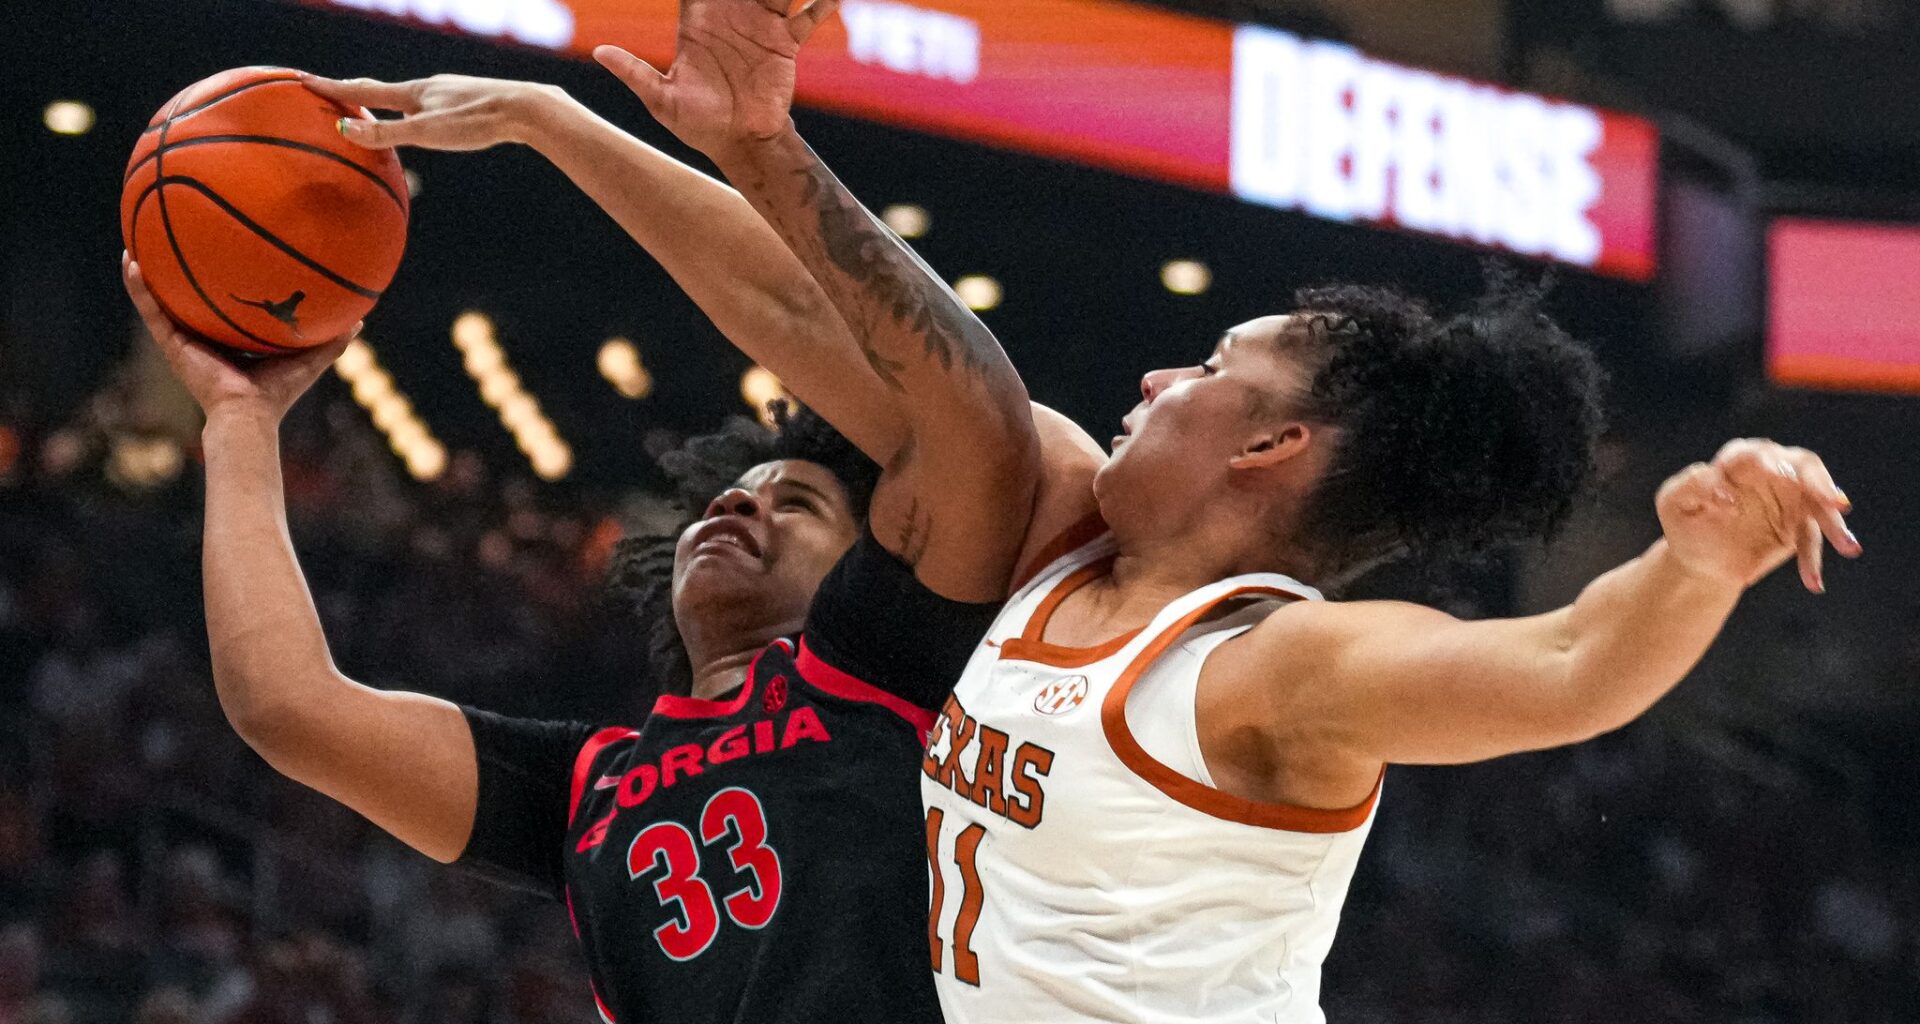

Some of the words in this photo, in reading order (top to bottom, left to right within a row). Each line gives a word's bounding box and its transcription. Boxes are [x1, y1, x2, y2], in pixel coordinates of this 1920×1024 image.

[1231, 24, 1602, 268] DEFENSE
[922, 690, 1055, 829] EXAS
[1034, 675, 1088, 715] SEC
[576, 706, 831, 853] GORGIA
[627, 787, 782, 962] 33
[926, 806, 986, 987] 11
